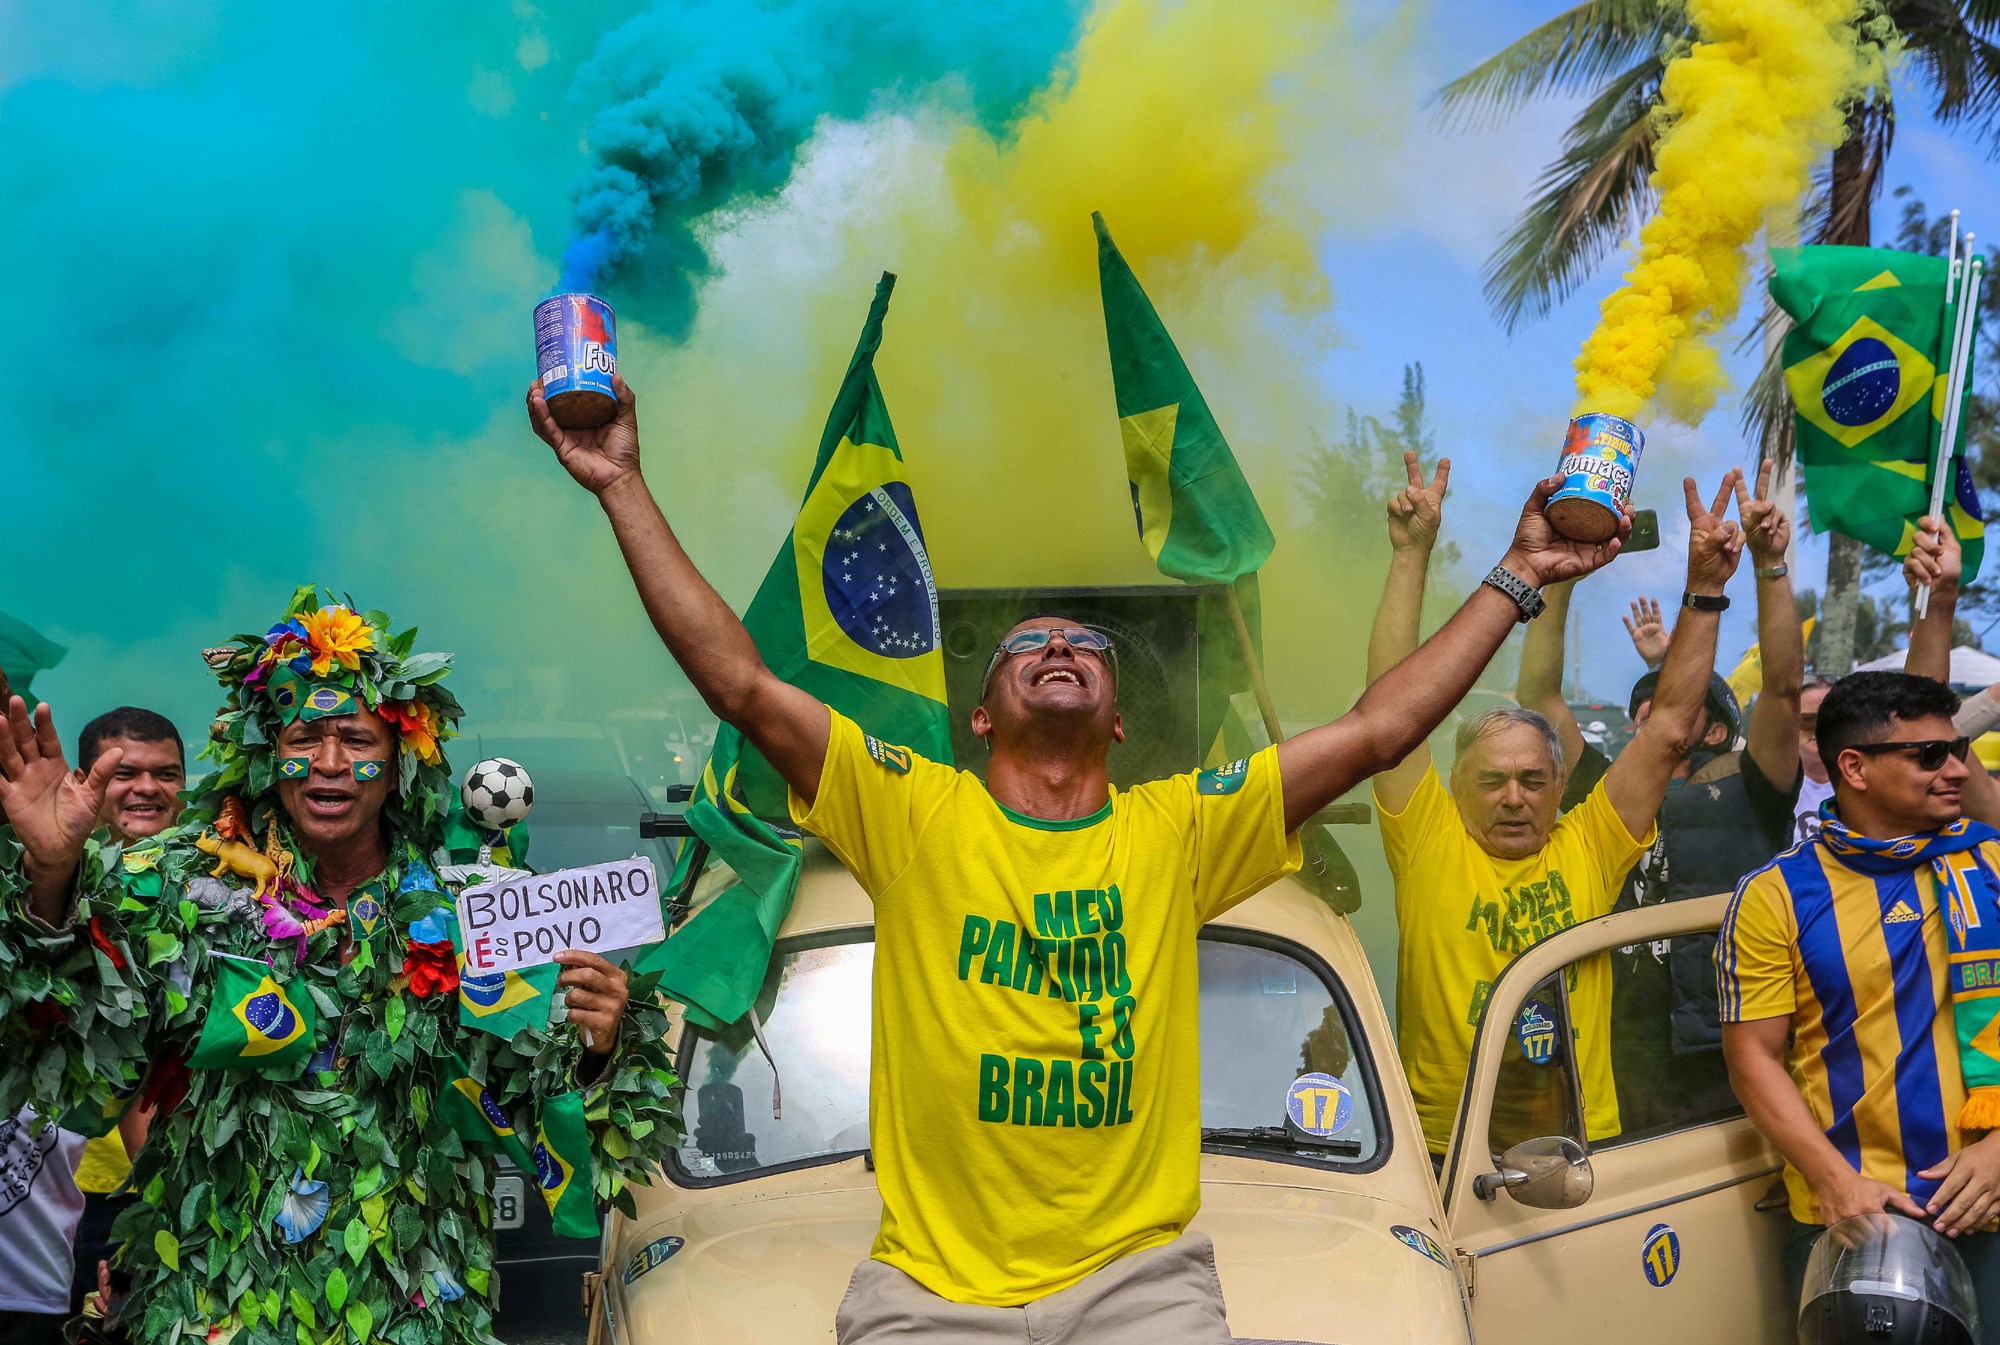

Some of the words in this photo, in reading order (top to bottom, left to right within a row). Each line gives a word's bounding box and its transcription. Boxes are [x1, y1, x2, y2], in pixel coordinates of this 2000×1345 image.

[877, 492, 911, 536] ORDEM
[909, 539, 919, 547] E
[915, 551, 942, 641] PROGRESSO
[466, 868, 650, 930] BOLSONARO
[1034, 884, 1123, 938] MEU
[1884, 912, 1921, 924] adidas
[475, 931, 495, 969] É
[514, 916, 601, 962] POVO
[958, 914, 1132, 1003] PARTIDO
[1111, 995, 1136, 1060] O
[1523, 1033, 1554, 1059] 177
[978, 1053, 1134, 1129] BRASIL
[1294, 1087, 1340, 1129] 17
[1646, 1232, 1675, 1285] 17
